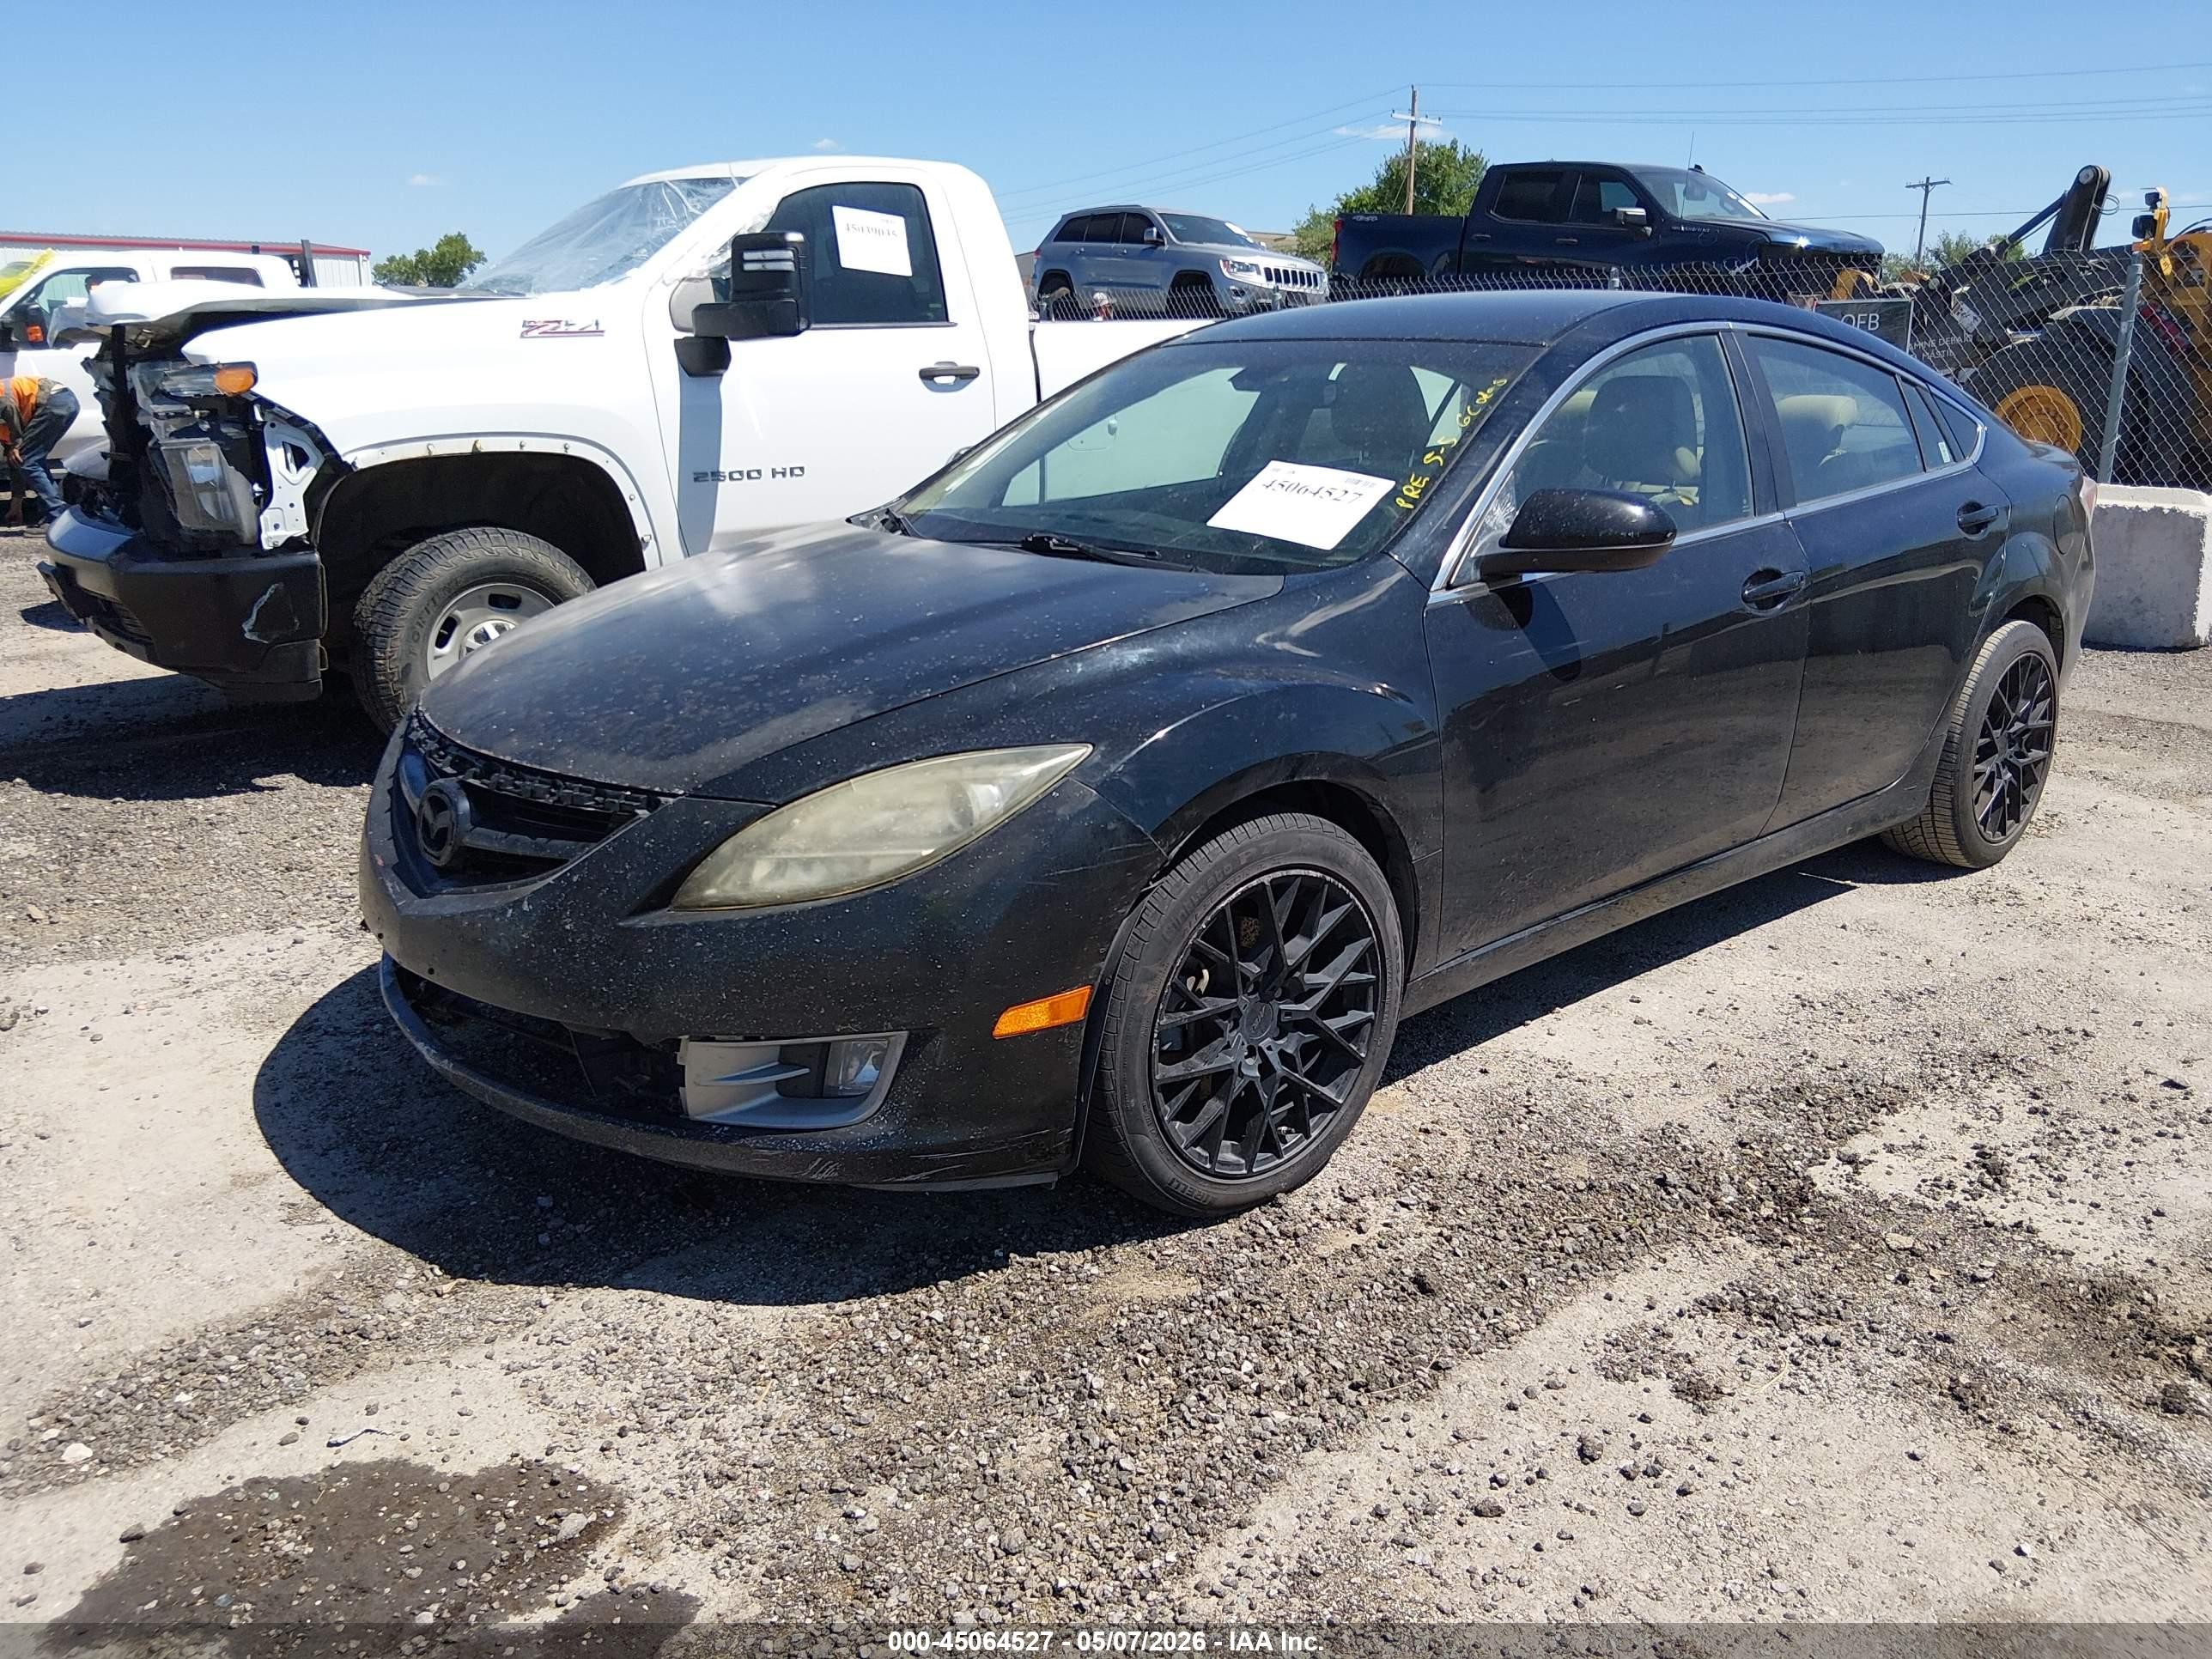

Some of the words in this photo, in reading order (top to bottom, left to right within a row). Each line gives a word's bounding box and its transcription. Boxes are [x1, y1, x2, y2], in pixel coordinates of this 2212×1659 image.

[693, 469, 763, 483] 2500
[771, 466, 805, 478] HD
[1262, 479, 1364, 504] 45064527
